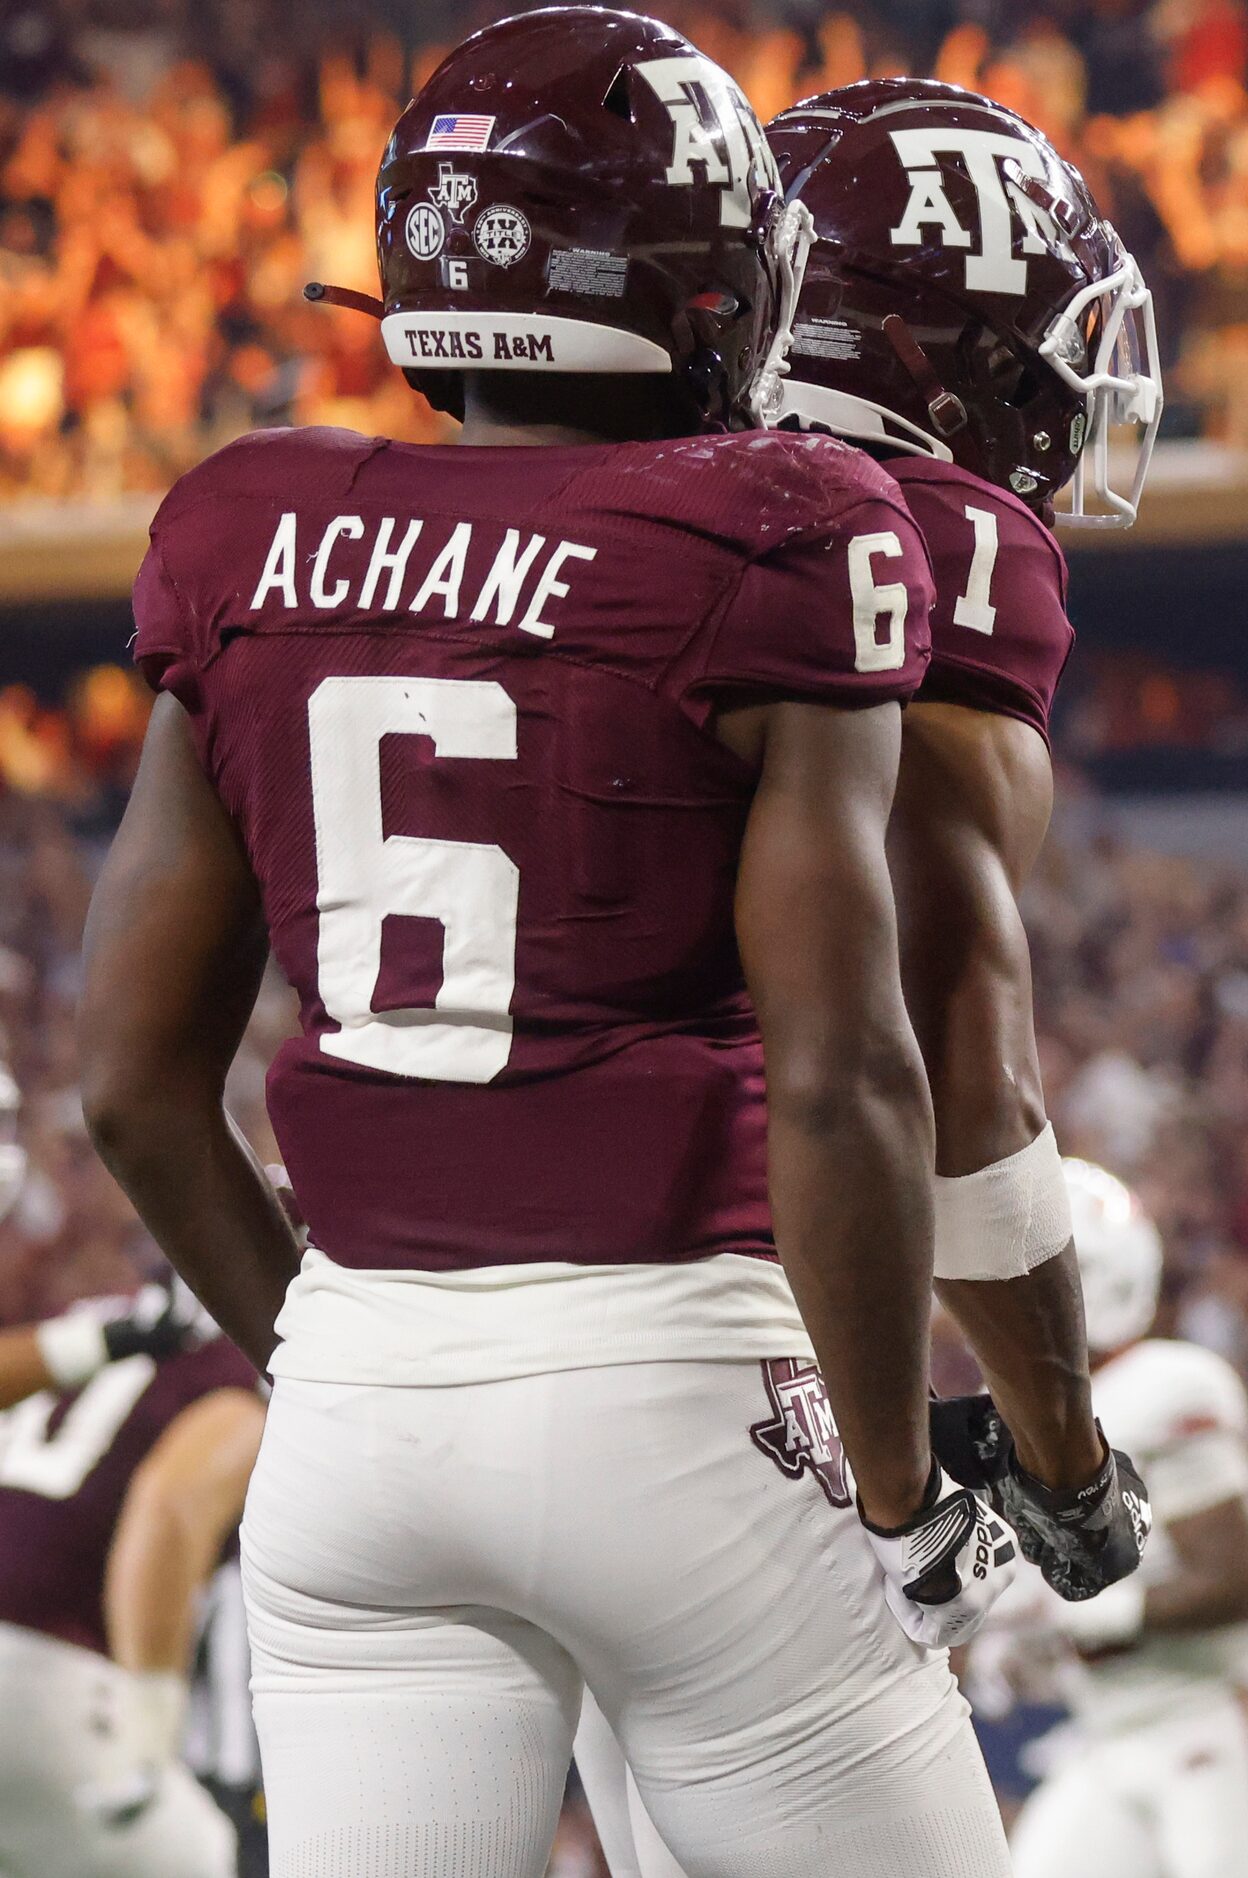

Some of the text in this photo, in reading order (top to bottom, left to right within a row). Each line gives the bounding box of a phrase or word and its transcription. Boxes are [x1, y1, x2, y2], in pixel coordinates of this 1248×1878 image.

[409, 207, 440, 255] SEC
[448, 260, 469, 290] 6
[404, 329, 555, 362] TEXAS A&M
[250, 512, 598, 640] ACHANE
[846, 530, 909, 673] 6
[953, 504, 998, 635] 1
[307, 675, 520, 1084] 6
